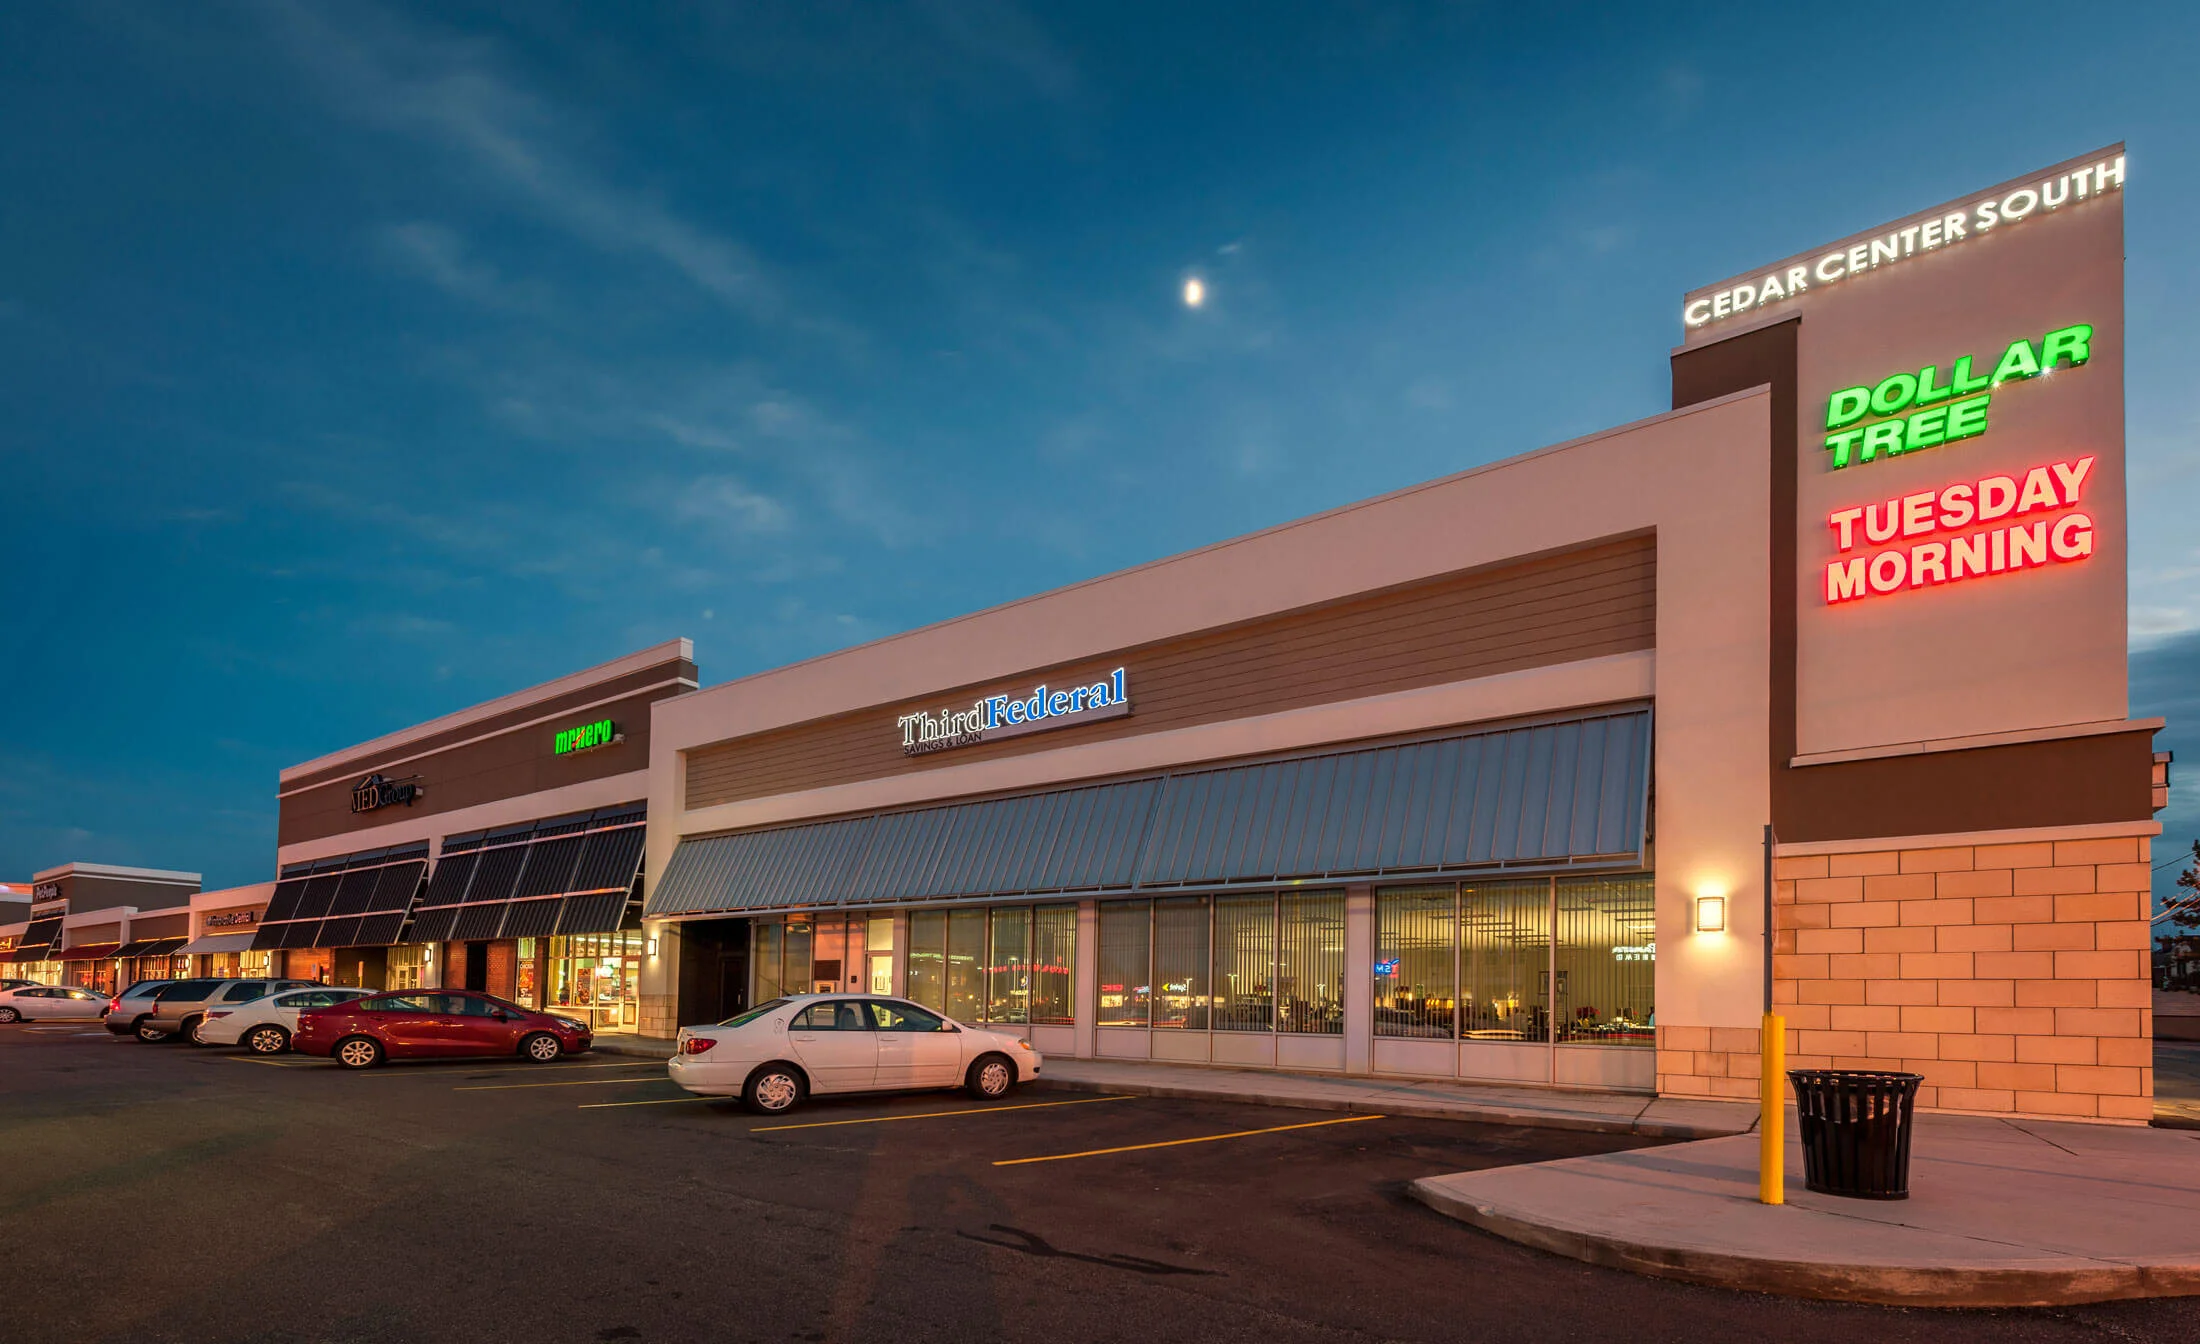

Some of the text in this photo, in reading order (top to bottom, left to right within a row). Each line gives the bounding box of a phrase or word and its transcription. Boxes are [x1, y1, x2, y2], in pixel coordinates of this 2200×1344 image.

[1684, 156, 2126, 327] CEDAR CENTER SOUTH
[1826, 324, 2093, 430] DOLLAR
[1825, 394, 1991, 470] TREE
[1829, 456, 2094, 552] TUESDAY
[1826, 513, 2093, 604] MORNING
[902, 731, 982, 755] SAVINGS & LOAN
